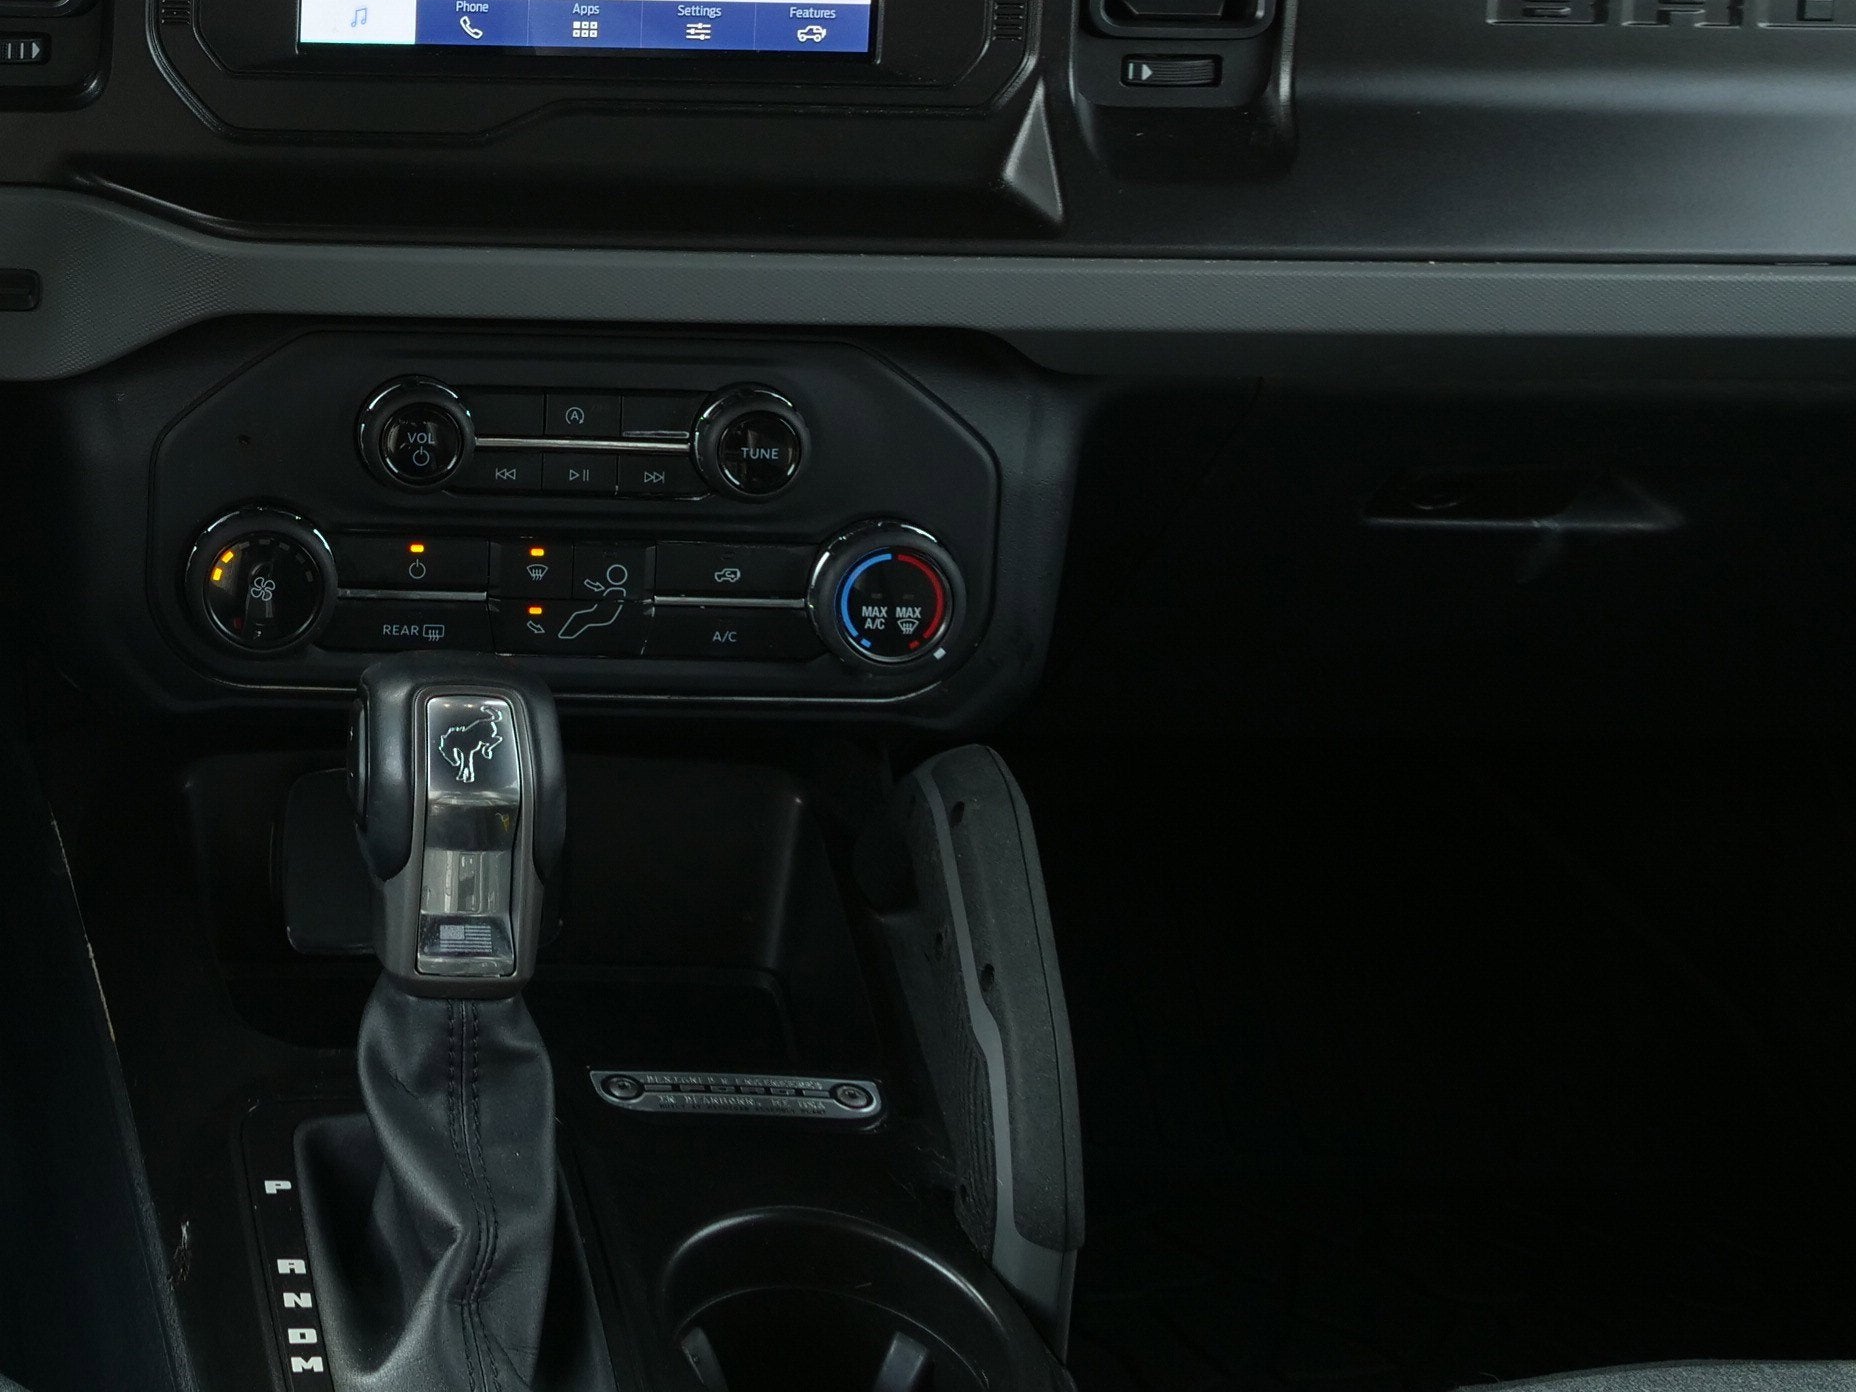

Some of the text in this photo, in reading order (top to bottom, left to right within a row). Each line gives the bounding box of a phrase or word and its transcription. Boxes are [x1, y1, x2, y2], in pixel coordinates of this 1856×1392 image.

[455, 0, 489, 14] Phone
[572, 2, 600, 18] Apps
[677, 4, 722, 20] Settings
[789, 6, 836, 20] Features
[407, 431, 435, 445] VOL
[740, 446, 779, 460] TUNE
[861, 605, 888, 618] MAX
[895, 606, 921, 619] MAX
[382, 624, 419, 637] REAR
[864, 617, 886, 630] A/C
[712, 630, 737, 643] A/C
[264, 1179, 292, 1195] P
[276, 1258, 307, 1275] R
[282, 1292, 313, 1309] N
[287, 1328, 318, 1345] D
[290, 1356, 324, 1373] M
